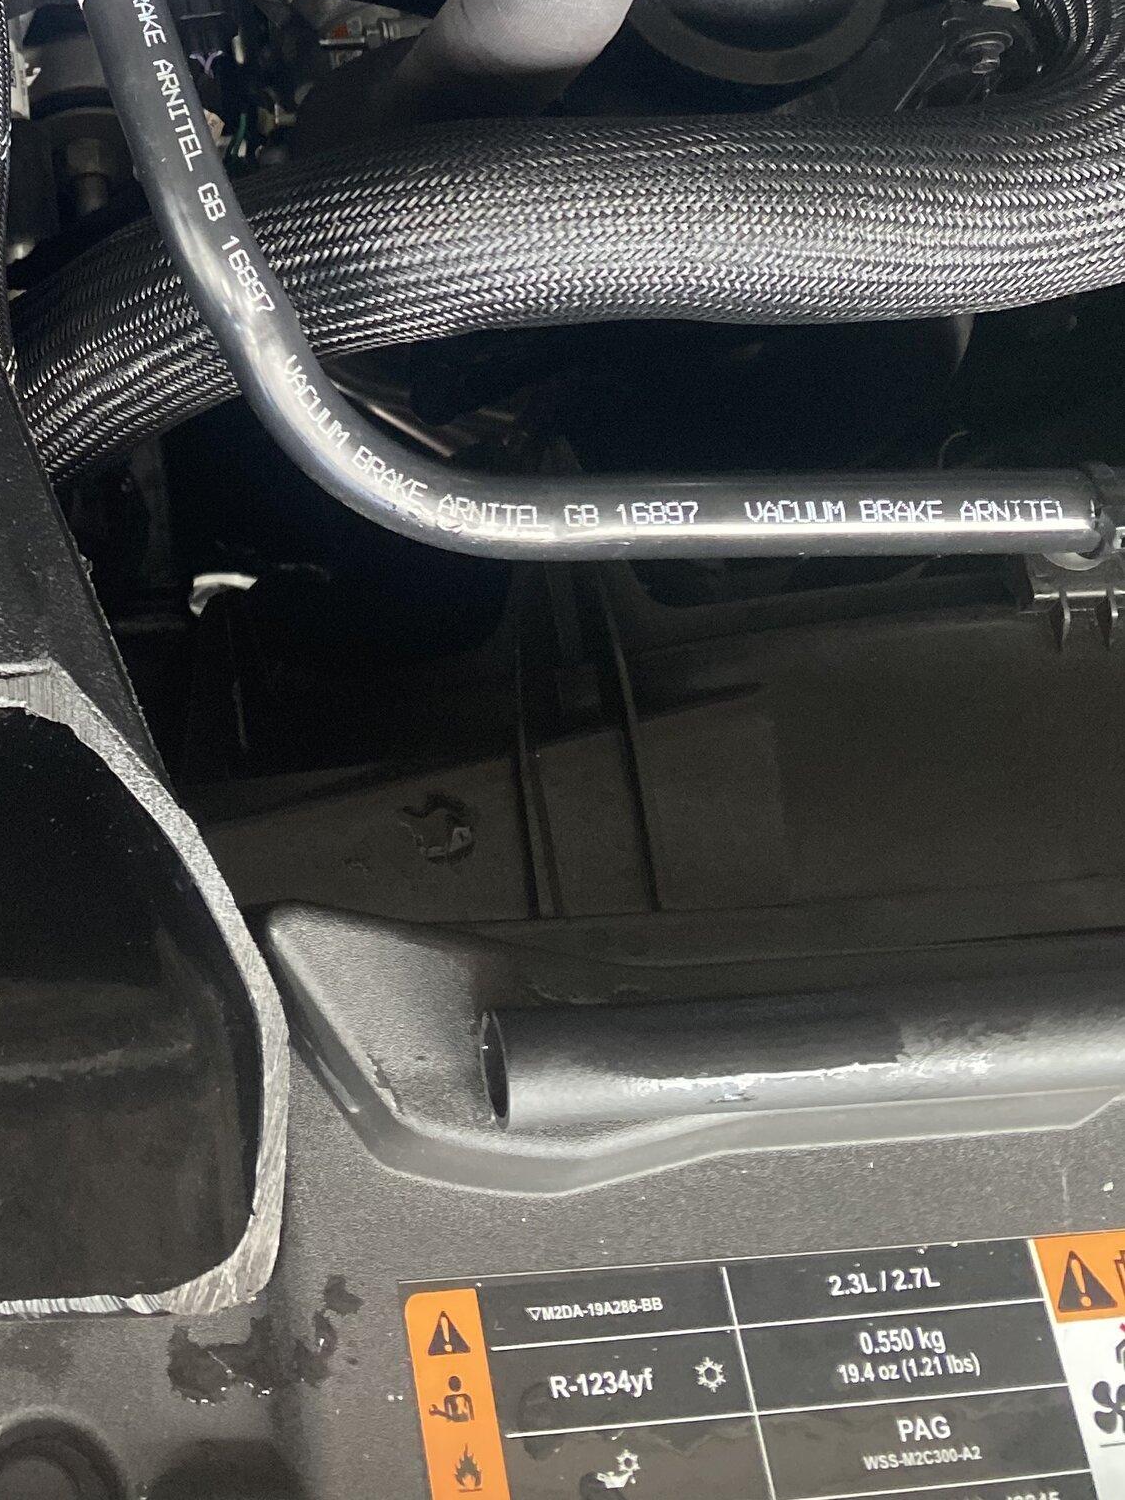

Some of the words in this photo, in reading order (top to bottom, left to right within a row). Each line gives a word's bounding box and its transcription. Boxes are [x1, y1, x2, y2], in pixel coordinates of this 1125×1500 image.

[152, 58, 205, 172] ARNITEL
[197, 182, 227, 222] GB
[220, 235, 275, 312] 16897
[282, 354, 350, 450] VACUUM
[351, 445, 428, 500] BRAKE
[436, 493, 549, 529] ARNITEL
[563, 502, 600, 527] GB
[615, 501, 700, 526] 16897
[744, 499, 847, 523] VACUUM
[858, 499, 944, 523] BRAKE
[827, 1272, 878, 1297] 2.3L
[891, 1266, 941, 1292] 2.7L
[859, 1329, 914, 1355] 0.550
[916, 1326, 947, 1353] kg
[837, 1362, 875, 1384] 19.4
[878, 1363, 901, 1381] oz
[902, 1355, 944, 1383] (1.21
[946, 1351, 981, 1376] lbs)
[549, 1367, 654, 1400] R-1234yf
[896, 1416, 952, 1443] PAG
[863, 1446, 982, 1471] WSS-M2C300-A2
